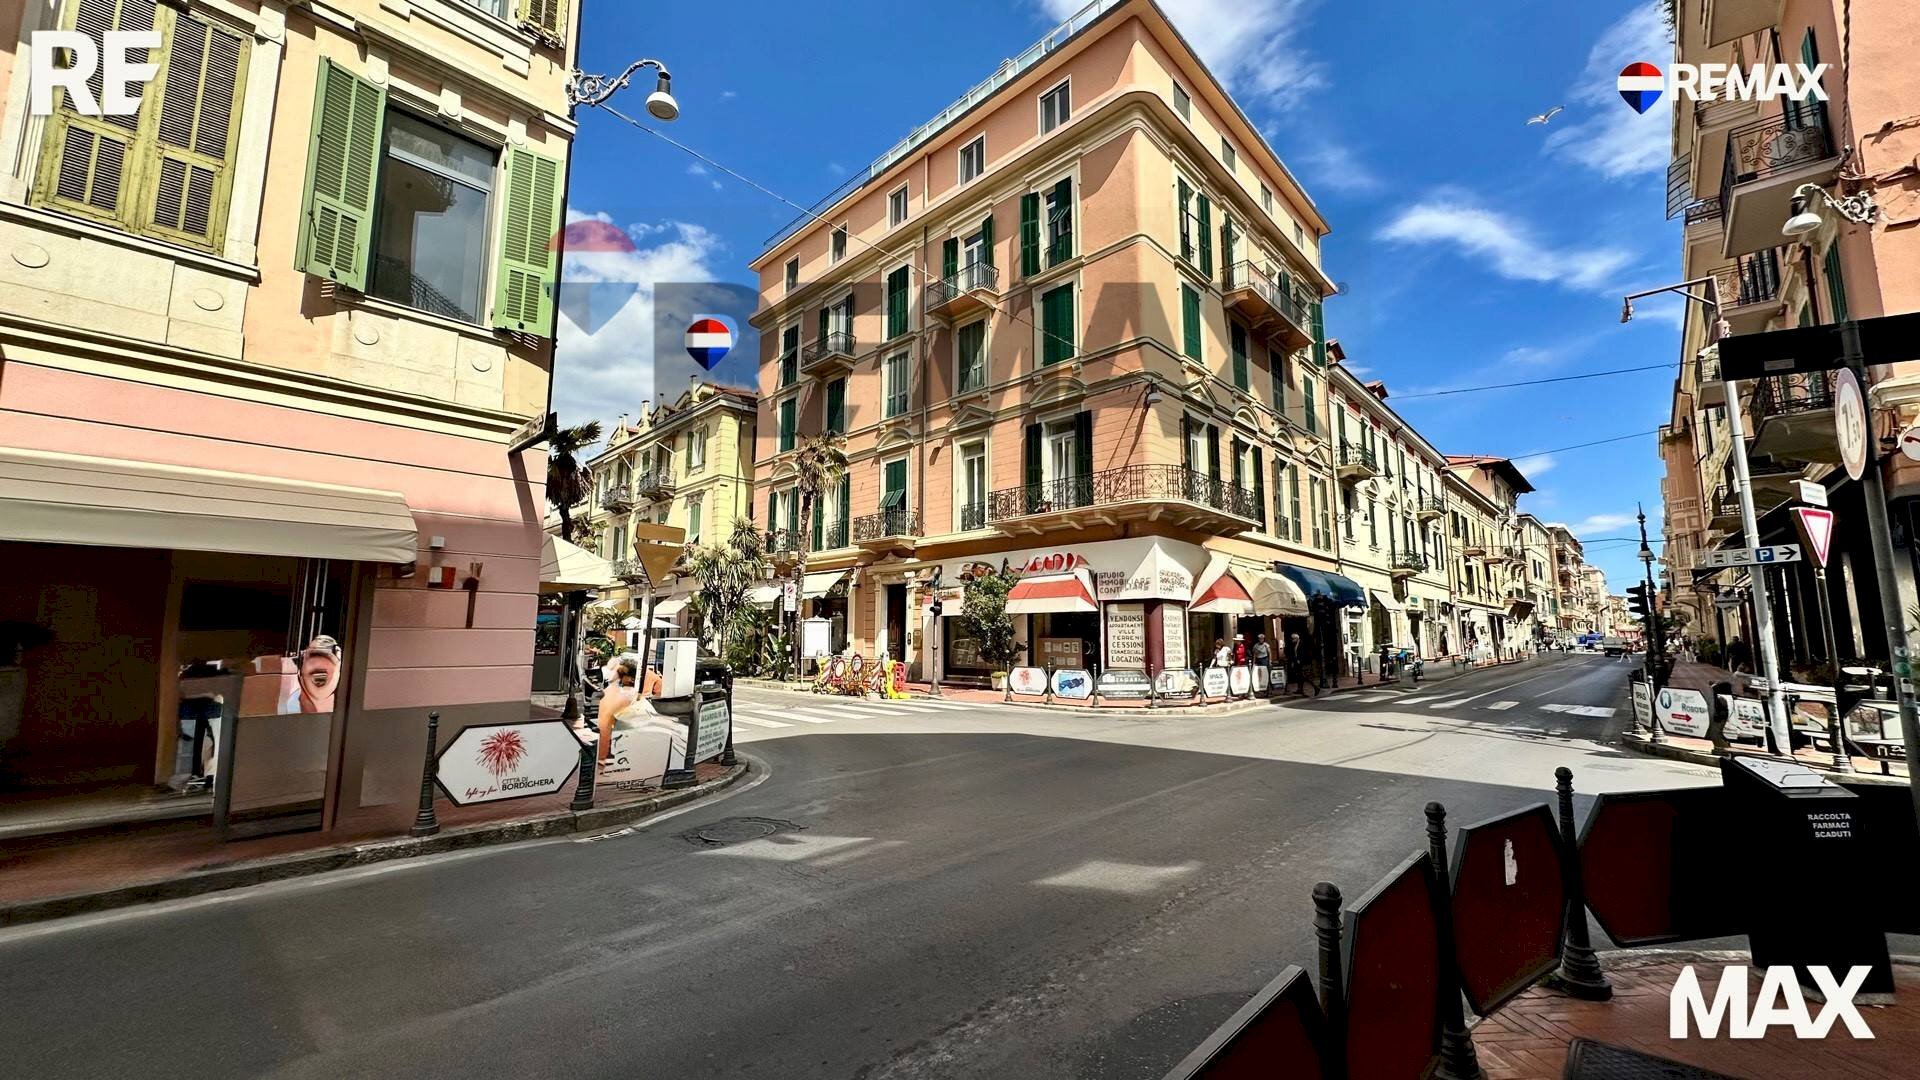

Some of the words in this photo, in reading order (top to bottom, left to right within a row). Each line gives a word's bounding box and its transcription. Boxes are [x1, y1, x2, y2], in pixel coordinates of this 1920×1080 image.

[1098, 571, 1125, 579] STUDIO
[501, 778, 555, 791] BORDIGHERA
[1807, 813, 1852, 821] RACCOLTA
